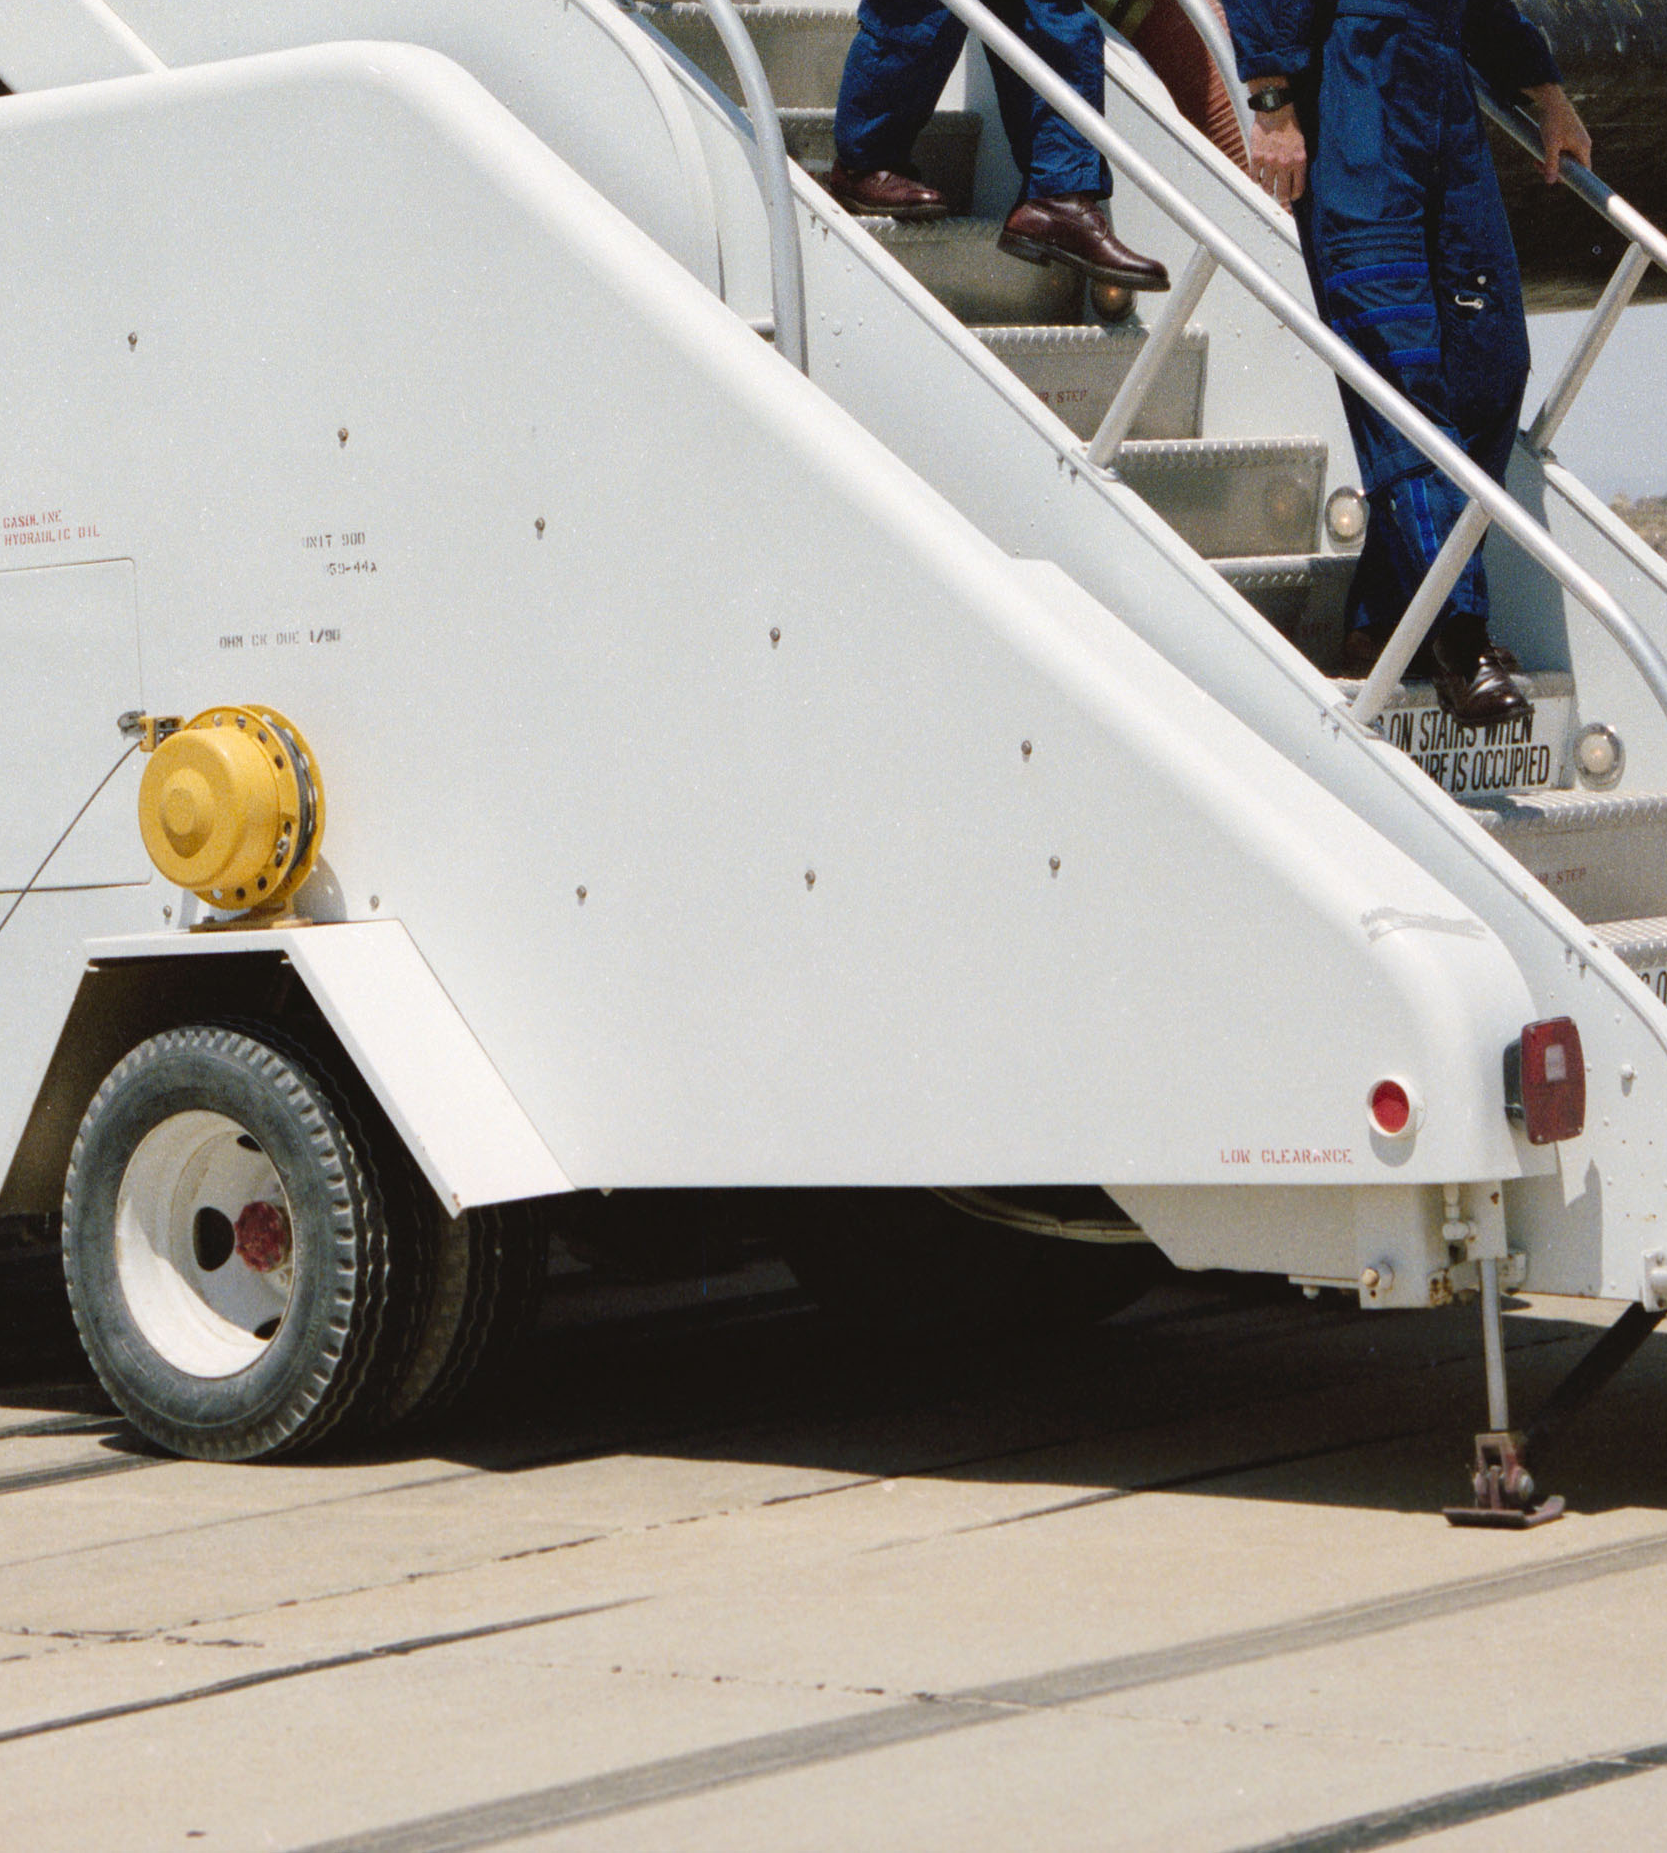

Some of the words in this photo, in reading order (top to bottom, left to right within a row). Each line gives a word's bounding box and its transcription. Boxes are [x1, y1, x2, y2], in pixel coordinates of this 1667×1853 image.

[1057, 389, 1086, 403] STEP
[3, 509, 62, 529] GASOLINE
[4, 528, 70, 546] HYDRAULIC
[78, 524, 101, 538] OIL
[1390, 712, 1414, 753] ON
[1451, 751, 1468, 792] IS
[1472, 745, 1550, 791] OCCUPIED
[1556, 867, 1586, 886] STEP
[1261, 1148, 1354, 1164] CLEARANCE
